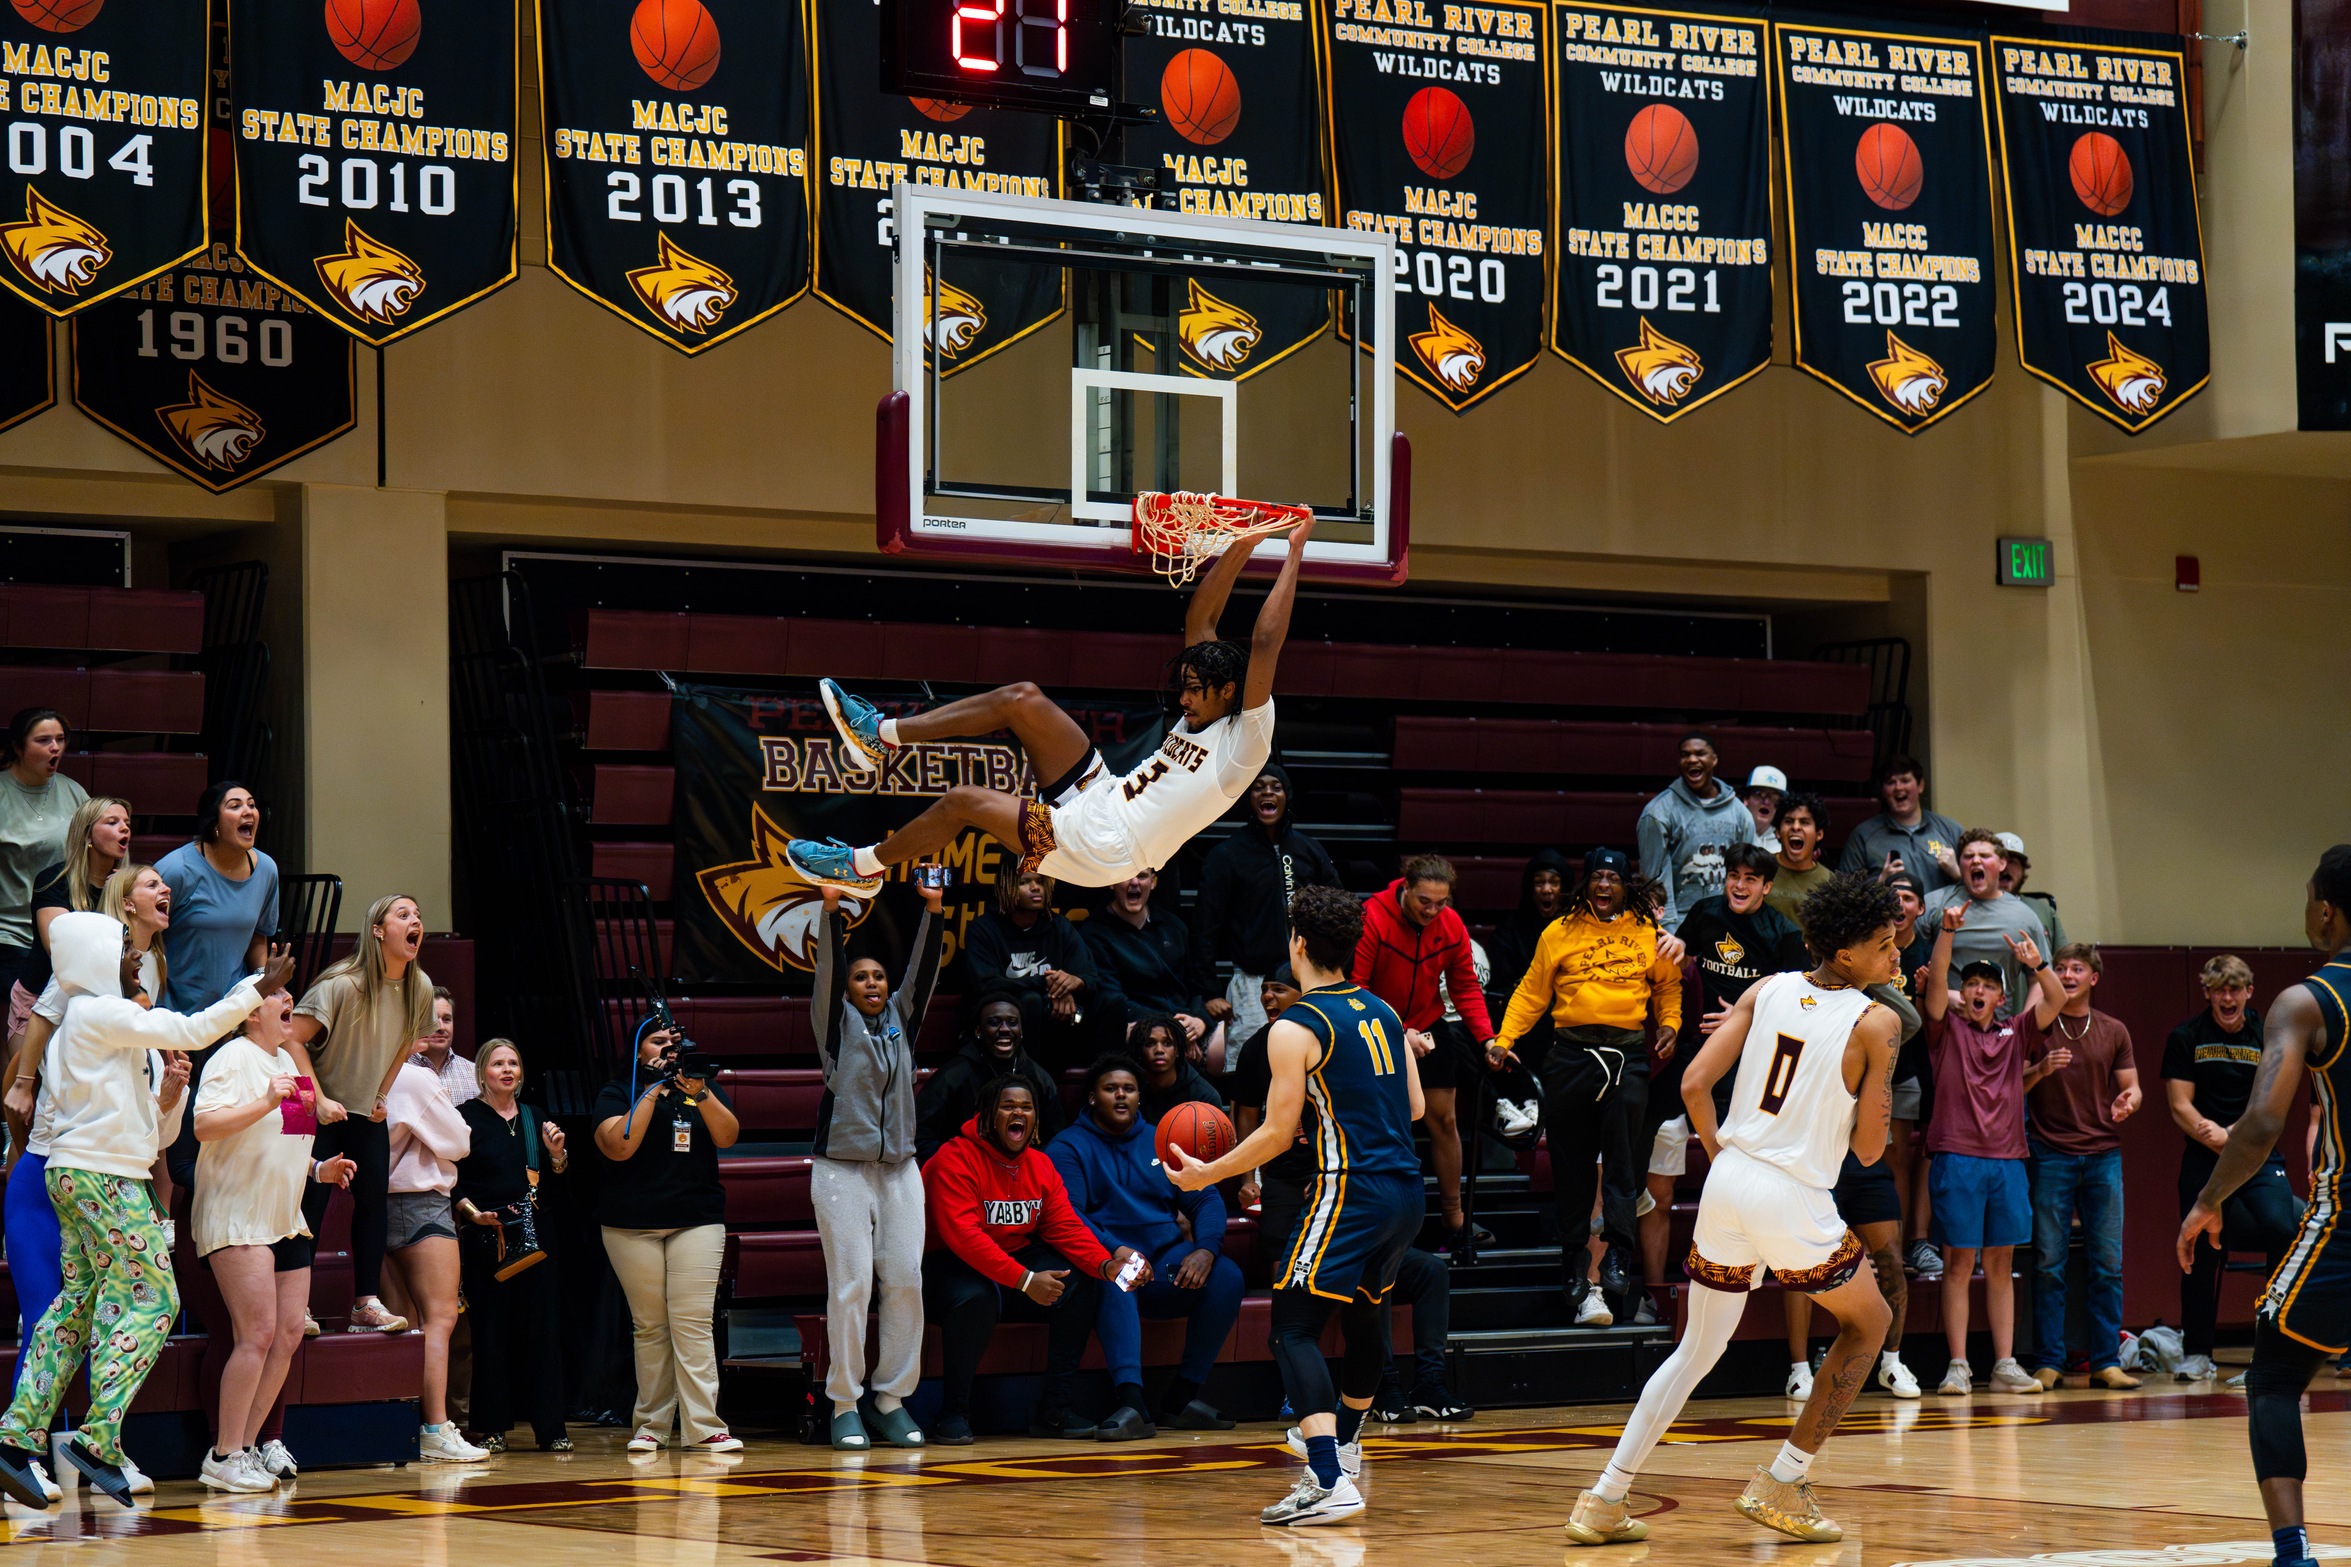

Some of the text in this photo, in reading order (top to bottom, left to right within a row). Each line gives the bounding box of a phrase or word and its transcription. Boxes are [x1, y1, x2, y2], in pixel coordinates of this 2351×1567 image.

[1218, 0, 1303, 20] COLLEGE
[1334, 0, 1535, 39] PEARL RIVER
[1147, 14, 1266, 46] ILDCATS
[1335, 22, 1536, 62] COMMUNITY COLLEGE
[1566, 13, 1757, 55] PEARL RIVER
[2, 40, 110, 83] MACJC
[1373, 51, 1501, 85] WILDCATS
[1566, 43, 1757, 77] COMMUNITY COLLEGE
[1789, 36, 1971, 76] PEARL RIVER
[2003, 47, 2173, 87] PEARL RIVER
[323, 79, 424, 118] MACJC
[1600, 71, 1724, 101] WILDCATS
[1792, 65, 1973, 97] COMMUNITY COLLEGE
[2006, 76, 2176, 107] COMMUNITY COLLEGE
[21, 81, 199, 129] CHAMPIONS
[632, 100, 728, 135] MACJC
[1833, 95, 1937, 122] WILDCATS
[2039, 102, 2149, 128] WILDCATS
[242, 108, 509, 162] STATE CHAMPIONS
[555, 128, 805, 177] STATE CHAMPIONS
[901, 129, 985, 166] MACJC
[298, 154, 456, 216] 2010
[830, 156, 1050, 199] STATE CHAMPIONS
[1163, 153, 1248, 187] MACJC
[607, 171, 762, 228] 2013
[1179, 188, 1322, 222] CHAMPIONS
[1404, 186, 1477, 220] MACJC
[1623, 202, 1700, 232] MACCC
[1347, 210, 1543, 256] STATE CHAMPIONS
[1568, 228, 1767, 265] STATE CHAMPIONS
[1862, 222, 1928, 250] MACCC
[2074, 224, 2144, 252] MACCC
[1395, 248, 1506, 303] 2020
[1816, 248, 1980, 283] STATE CHAMPIONS
[2025, 250, 2199, 284] STATE CHAMPIONS
[1597, 264, 1721, 313] 2021
[1842, 281, 1960, 328] 2022
[2063, 282, 2172, 328] 2024
[137, 308, 293, 368] 1960
[2011, 543, 2046, 578] EXIT
[1122, 757, 1171, 803] 3
[1282, 854, 1295, 891] Calvin
[1010, 951, 1036, 969] NIKE
[1619, 935, 1648, 969] RIVER
[1702, 957, 1762, 980] FOOTBALL
[1357, 1017, 1396, 1077] 11
[1758, 1032, 1806, 1116] 0
